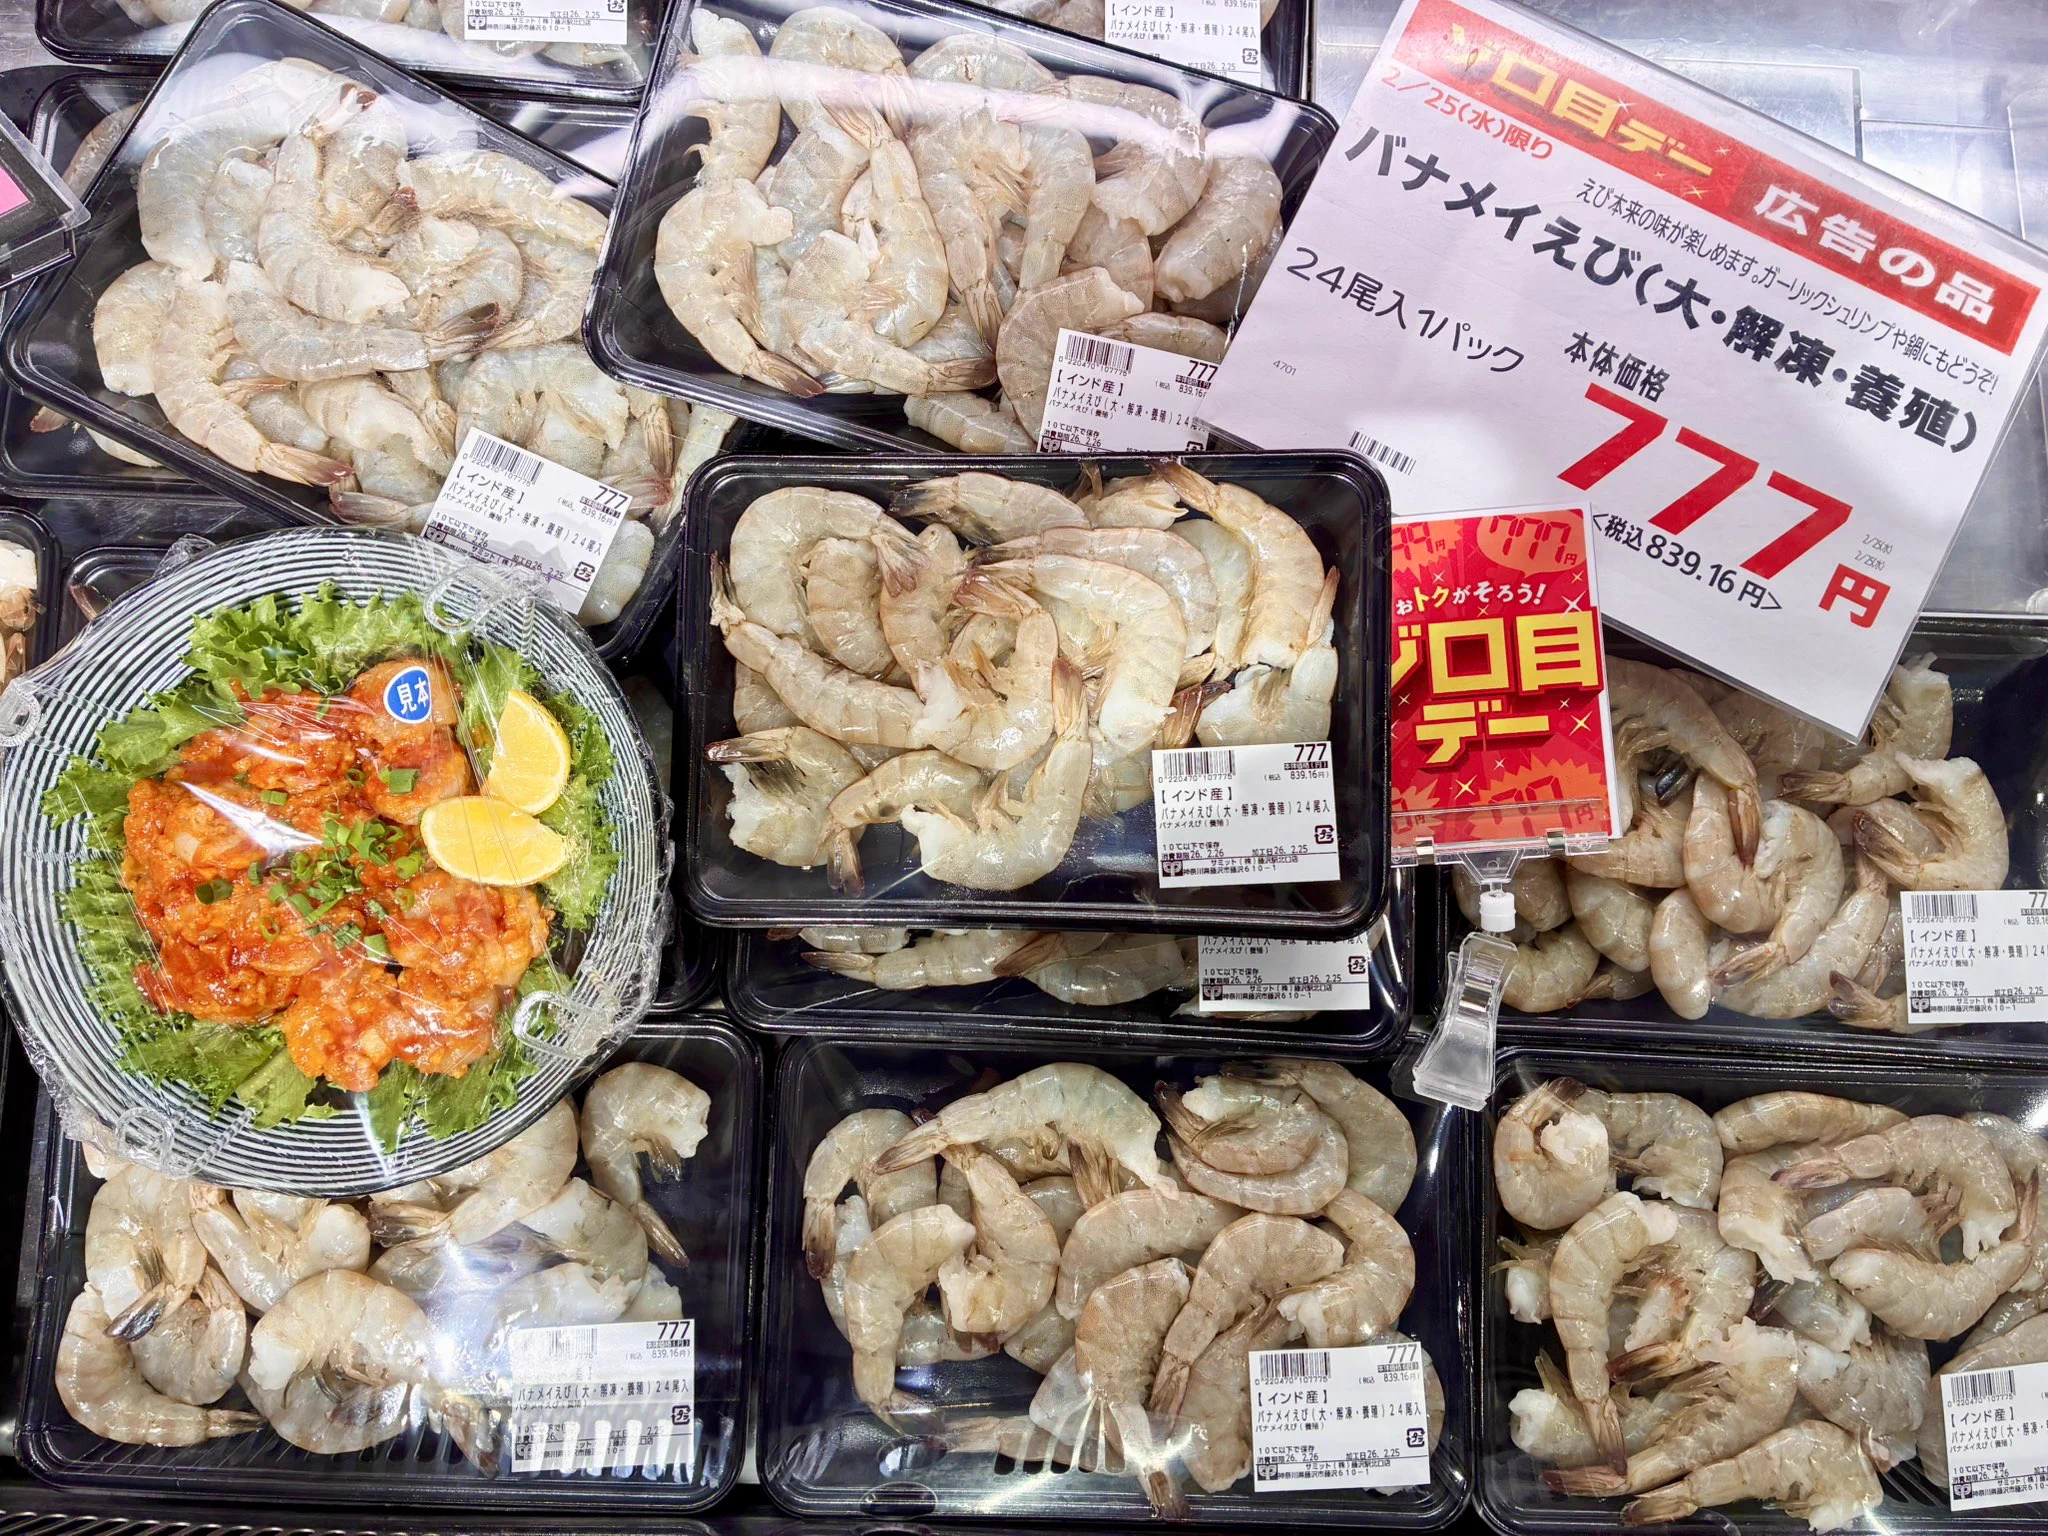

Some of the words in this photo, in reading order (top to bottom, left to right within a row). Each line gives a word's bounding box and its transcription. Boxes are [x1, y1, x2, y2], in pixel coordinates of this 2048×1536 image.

[1112, 4, 1173, 18] 【インド産】
[1380, 66, 1553, 160] 2/25(水)限り
[1753, 184, 1998, 324] 広告の品
[1345, 126, 1977, 453] バナメイえび(大・解凍・養殖)
[1576, 178, 1998, 395] えび本来の味が楽しめます。ガーリックシュリンプや鍋にもどうぞ!
[1188, 360, 1218, 381] 777
[1272, 359, 1297, 376] 4701
[1563, 331, 1670, 402] 本体価格
[1058, 369, 1123, 397] 【インド産】
[1053, 387, 1207, 432] バナメイえび(大・解凍・養殖)24
[456, 465, 524, 504] 【インド産】
[594, 486, 628, 509] 777
[449, 481, 603, 556] バナメイえび(大・解凍・養殖)24尾入
[1395, 581, 1547, 615] おトクがそろう!
[396, 677, 429, 715] 見本
[1415, 699, 1550, 764] デー
[1295, 744, 1327, 761] 777
[1169, 775, 1197, 783] 220470
[1203, 773, 1232, 781] 107775
[1162, 787, 1232, 803] 【インド産】
[1162, 800, 1330, 819] バナメイえび(大・解凍・養殖)24尾入
[1159, 819, 1229, 828] バナメイえび(養殖)
[1163, 842, 1220, 850] 10℃以下で保存
[1910, 930, 1976, 942] 【インド産】
[1910, 945, 2048, 959] バナメイえび(大・解凍・養殖)24
[658, 1322, 690, 1340] 777
[1387, 1344, 1417, 1363] 777
[519, 1379, 688, 1400] バナメイえび(大・解凍・養殖)24尾入
[1265, 1377, 1293, 1385] 220470
[1258, 1390, 1328, 1406] 【インド産】
[1258, 1402, 1421, 1422] バナメイえび(大・解凍・養殖)24尾入
[1951, 1407, 2014, 1427] 【インド産】
[1951, 1419, 2048, 1444] バナメイえび(大・解凍・
[1259, 1445, 1315, 1454] 10℃以下で保存
[1954, 1462, 2005, 1474] 10℃以下で保存
